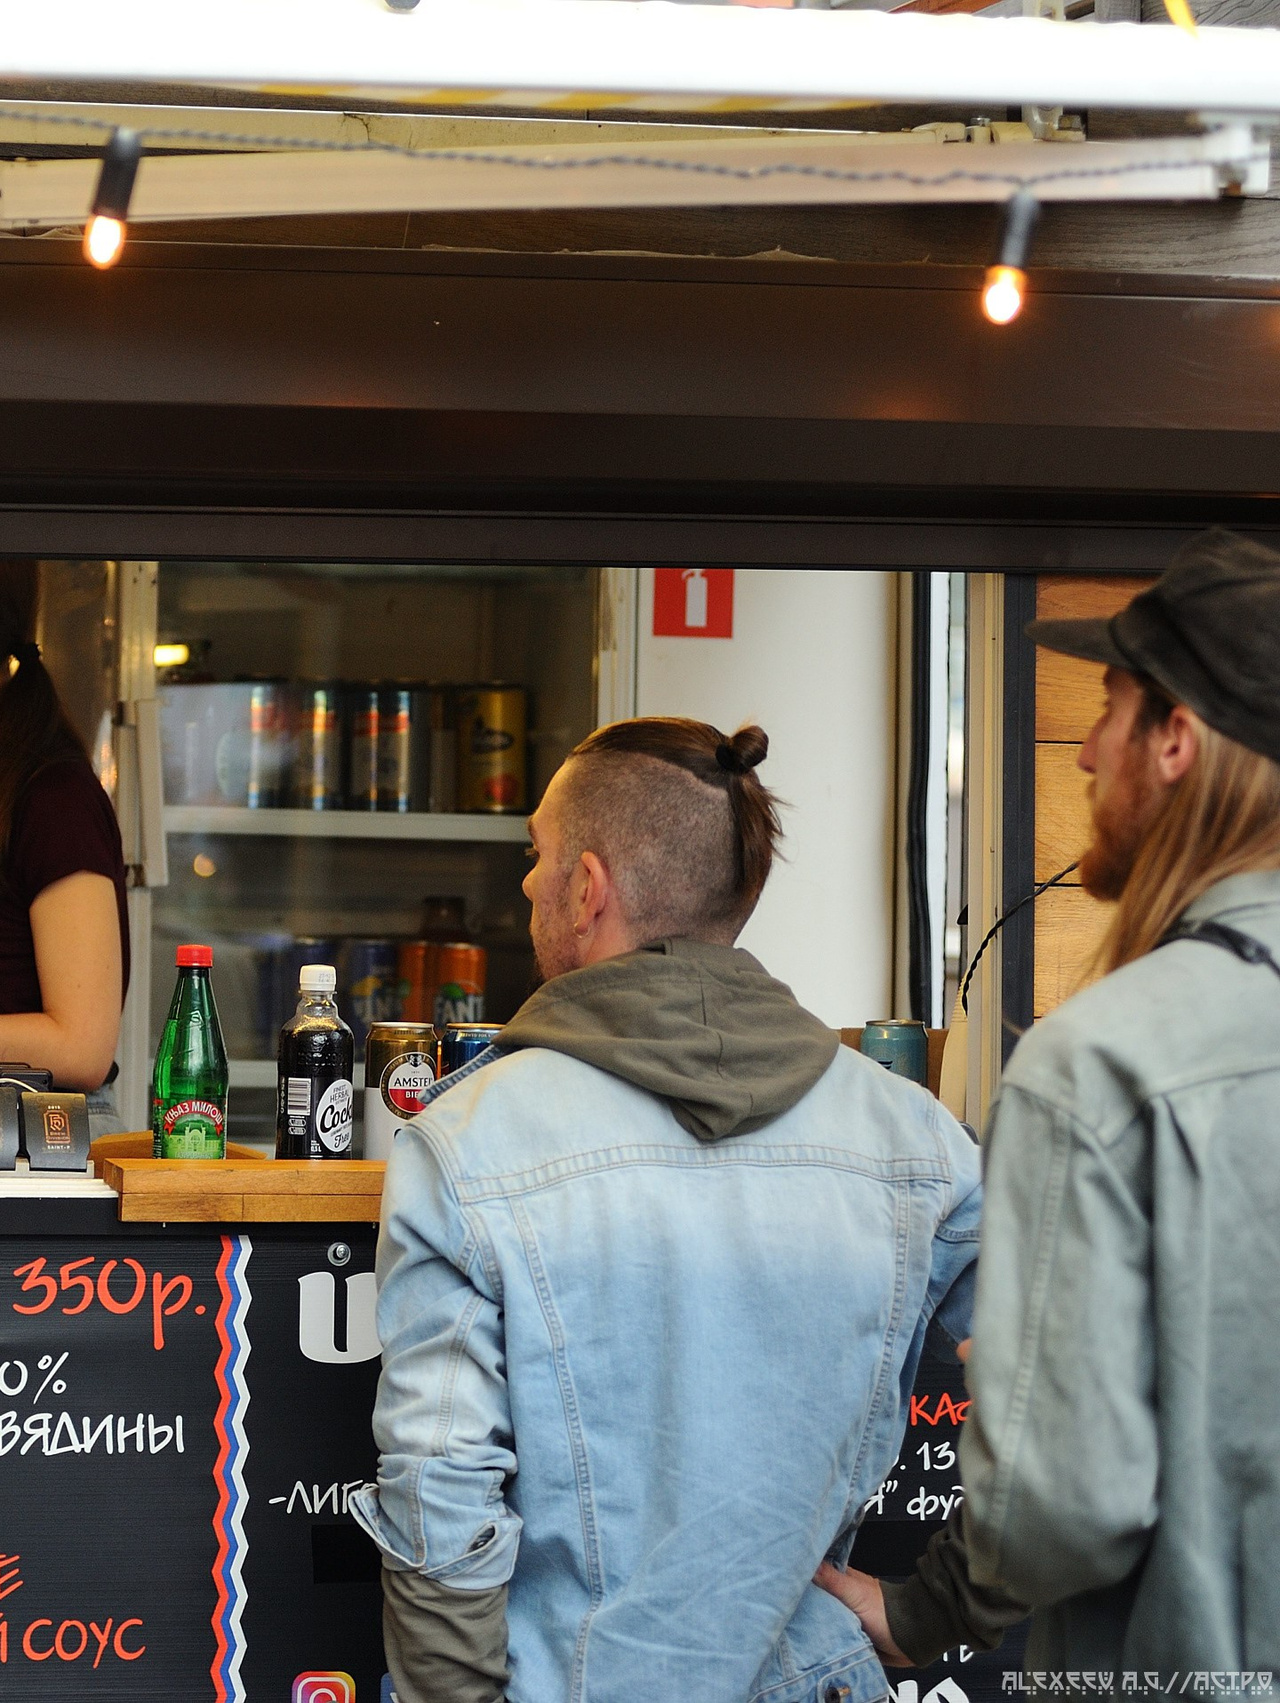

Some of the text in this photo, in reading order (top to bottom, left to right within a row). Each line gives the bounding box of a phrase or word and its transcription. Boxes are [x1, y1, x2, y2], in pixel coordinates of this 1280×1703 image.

[191, 1101, 223, 1125] МИЛОШ
[12, 1256, 207, 1350] 350р.
[22, 1618, 146, 1668] СОУС
